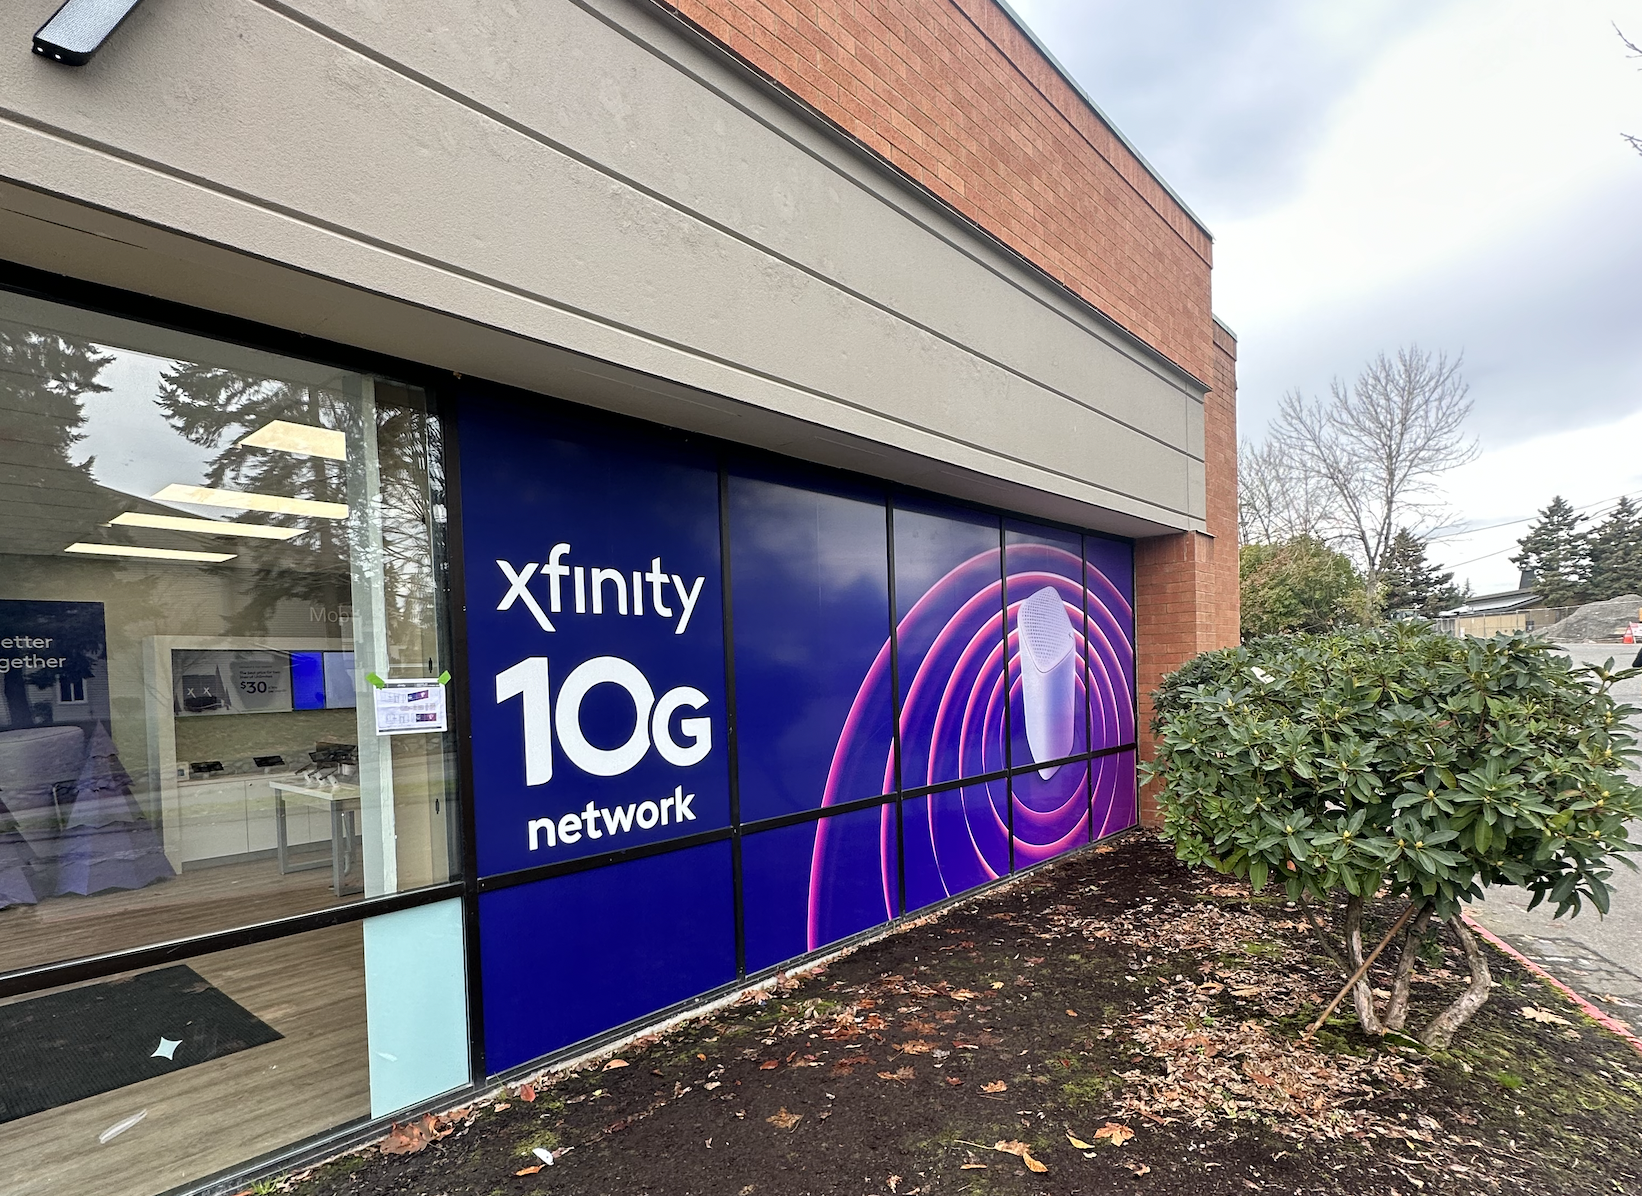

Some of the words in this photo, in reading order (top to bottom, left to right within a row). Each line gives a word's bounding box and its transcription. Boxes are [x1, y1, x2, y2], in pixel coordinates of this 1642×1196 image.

[495, 542, 706, 635] xfinity
[240, 681, 267, 694] $30
[495, 656, 712, 787] 10G
[527, 785, 697, 852] network
